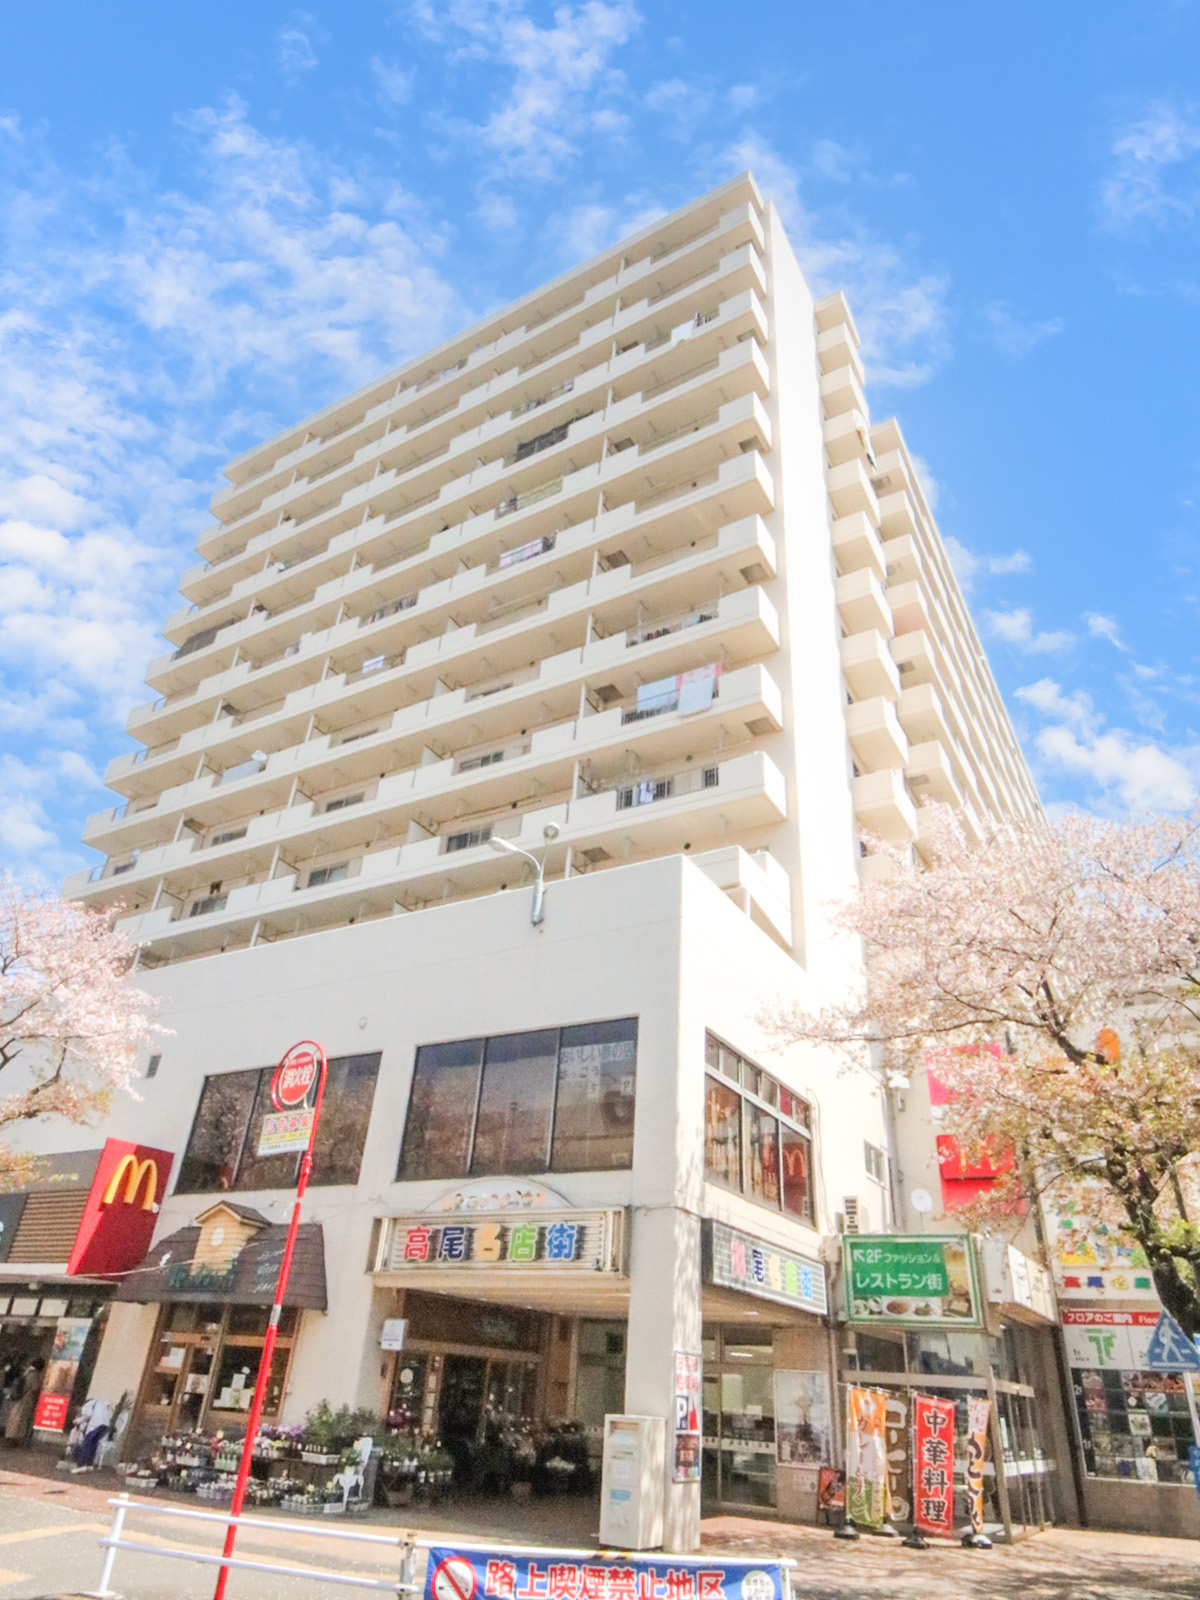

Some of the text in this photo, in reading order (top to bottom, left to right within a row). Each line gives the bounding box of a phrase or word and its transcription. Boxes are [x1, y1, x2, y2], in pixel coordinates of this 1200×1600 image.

[282, 1065, 313, 1089] 消火栓
[404, 1223, 578, 1262] 高尾名店街
[856, 1273, 943, 1291] レストラン街
[1067, 1312, 1134, 1324] フロアのご案内
[923, 1408, 949, 1524] 中華料理
[486, 1560, 725, 1600] 路上喫煙禁止地区
